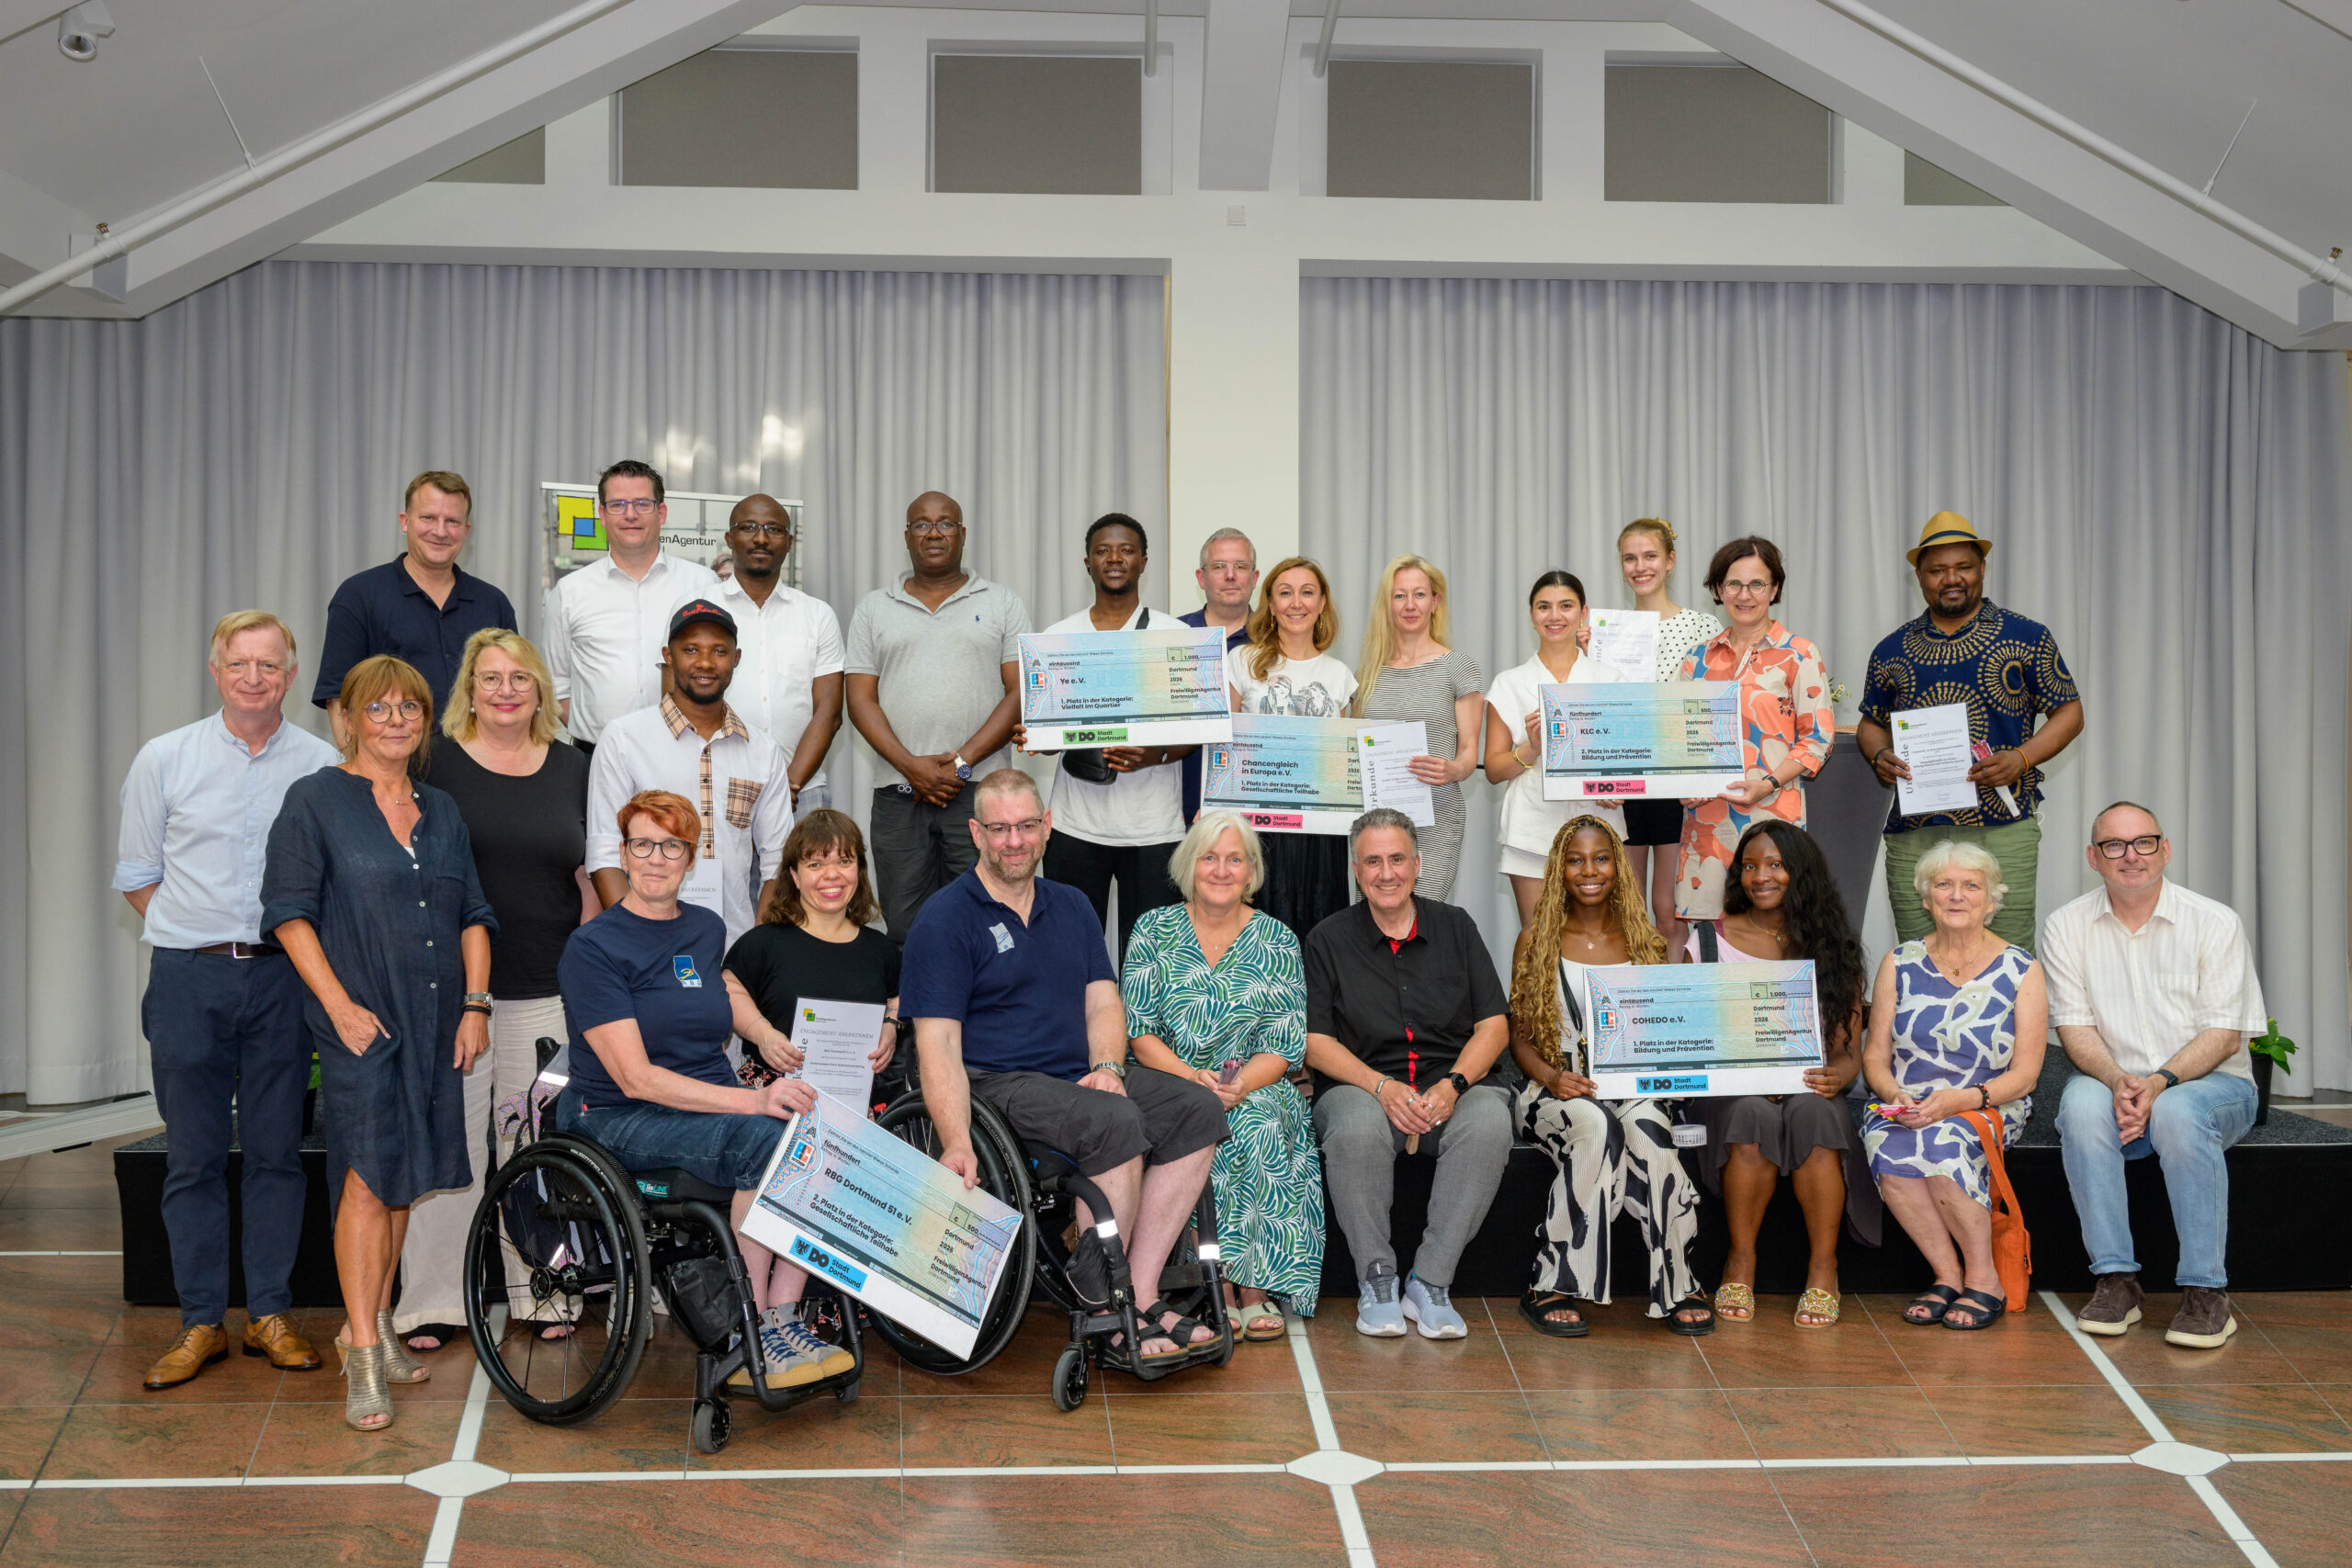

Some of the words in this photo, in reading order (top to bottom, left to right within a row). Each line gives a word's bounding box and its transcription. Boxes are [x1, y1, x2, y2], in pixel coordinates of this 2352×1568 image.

[1078, 731, 1095, 740] DO
[1242, 759, 1298, 769] Chancengleich
[1250, 768, 1276, 776] Europa
[1241, 784, 1292, 795] Gesellschaftliche
[1598, 783, 1613, 792] DO
[1255, 815, 1271, 825] DO
[1632, 1016, 1668, 1024] COHEDO
[1755, 1028, 1812, 1036] FreiwilligenAgentur
[1634, 1046, 1660, 1055] Bildung
[1653, 1078, 1671, 1089] DO
[824, 1140, 861, 1165] fünfhundert
[825, 1168, 842, 1183] RBG
[843, 1179, 888, 1210] Dortmund
[888, 1205, 897, 1215] 51
[897, 1213, 903, 1221] e.
[902, 1214, 912, 1225] V.
[813, 1194, 820, 1202] 2.
[820, 1198, 838, 1213] Platz
[838, 1208, 846, 1217] in
[846, 1214, 858, 1224] der
[856, 1221, 893, 1245] Kategorie:
[810, 1202, 869, 1240] Gesellschaftliche
[870, 1235, 899, 1257] Teilhabe
[944, 1229, 975, 1250] Dortmund
[939, 1241, 954, 1253] 2026
[808, 1247, 830, 1268] DO
[832, 1259, 850, 1273] Stadt
[829, 1266, 861, 1288] Dortmund
[931, 1263, 960, 1284] Dortmund
[933, 1256, 987, 1290] FreiwilligenAgentur
